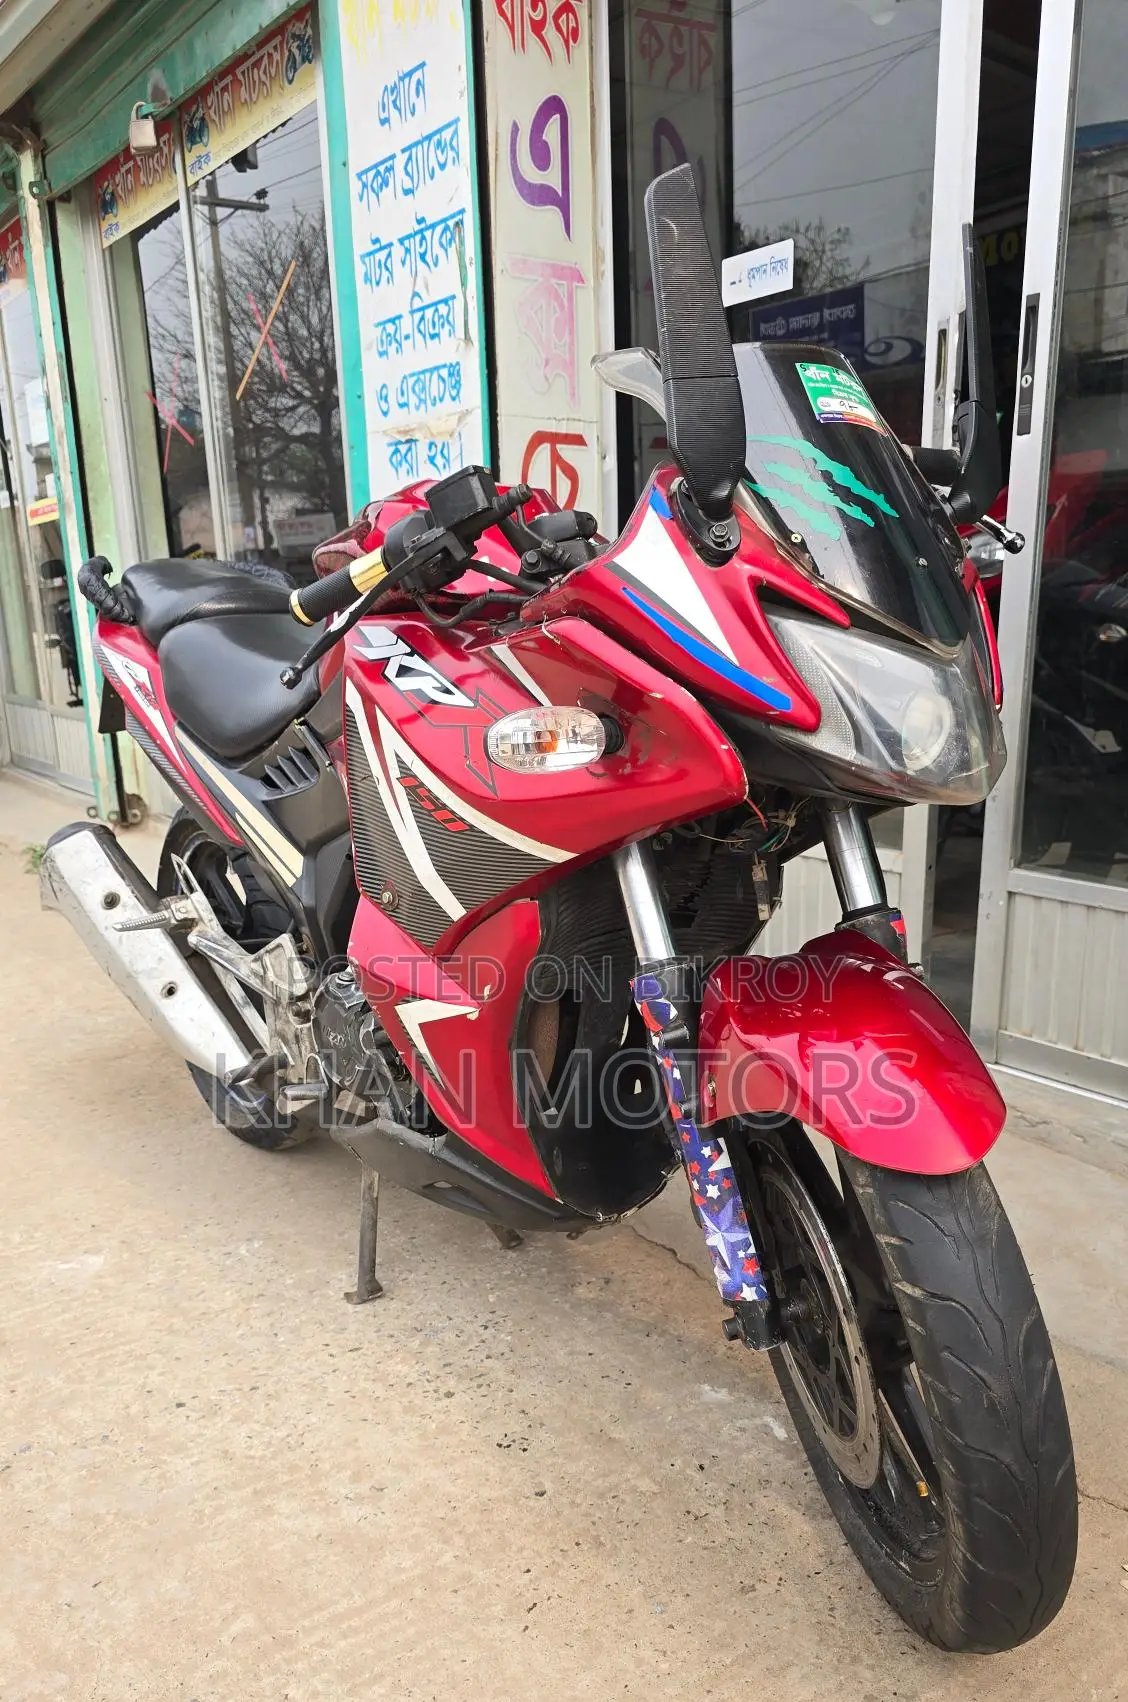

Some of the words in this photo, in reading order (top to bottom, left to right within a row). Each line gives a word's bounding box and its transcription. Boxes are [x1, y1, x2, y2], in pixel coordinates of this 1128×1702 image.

[377, 60, 427, 133] এখানে
[356, 153, 397, 213] সকল
[396, 775, 471, 833] 150
